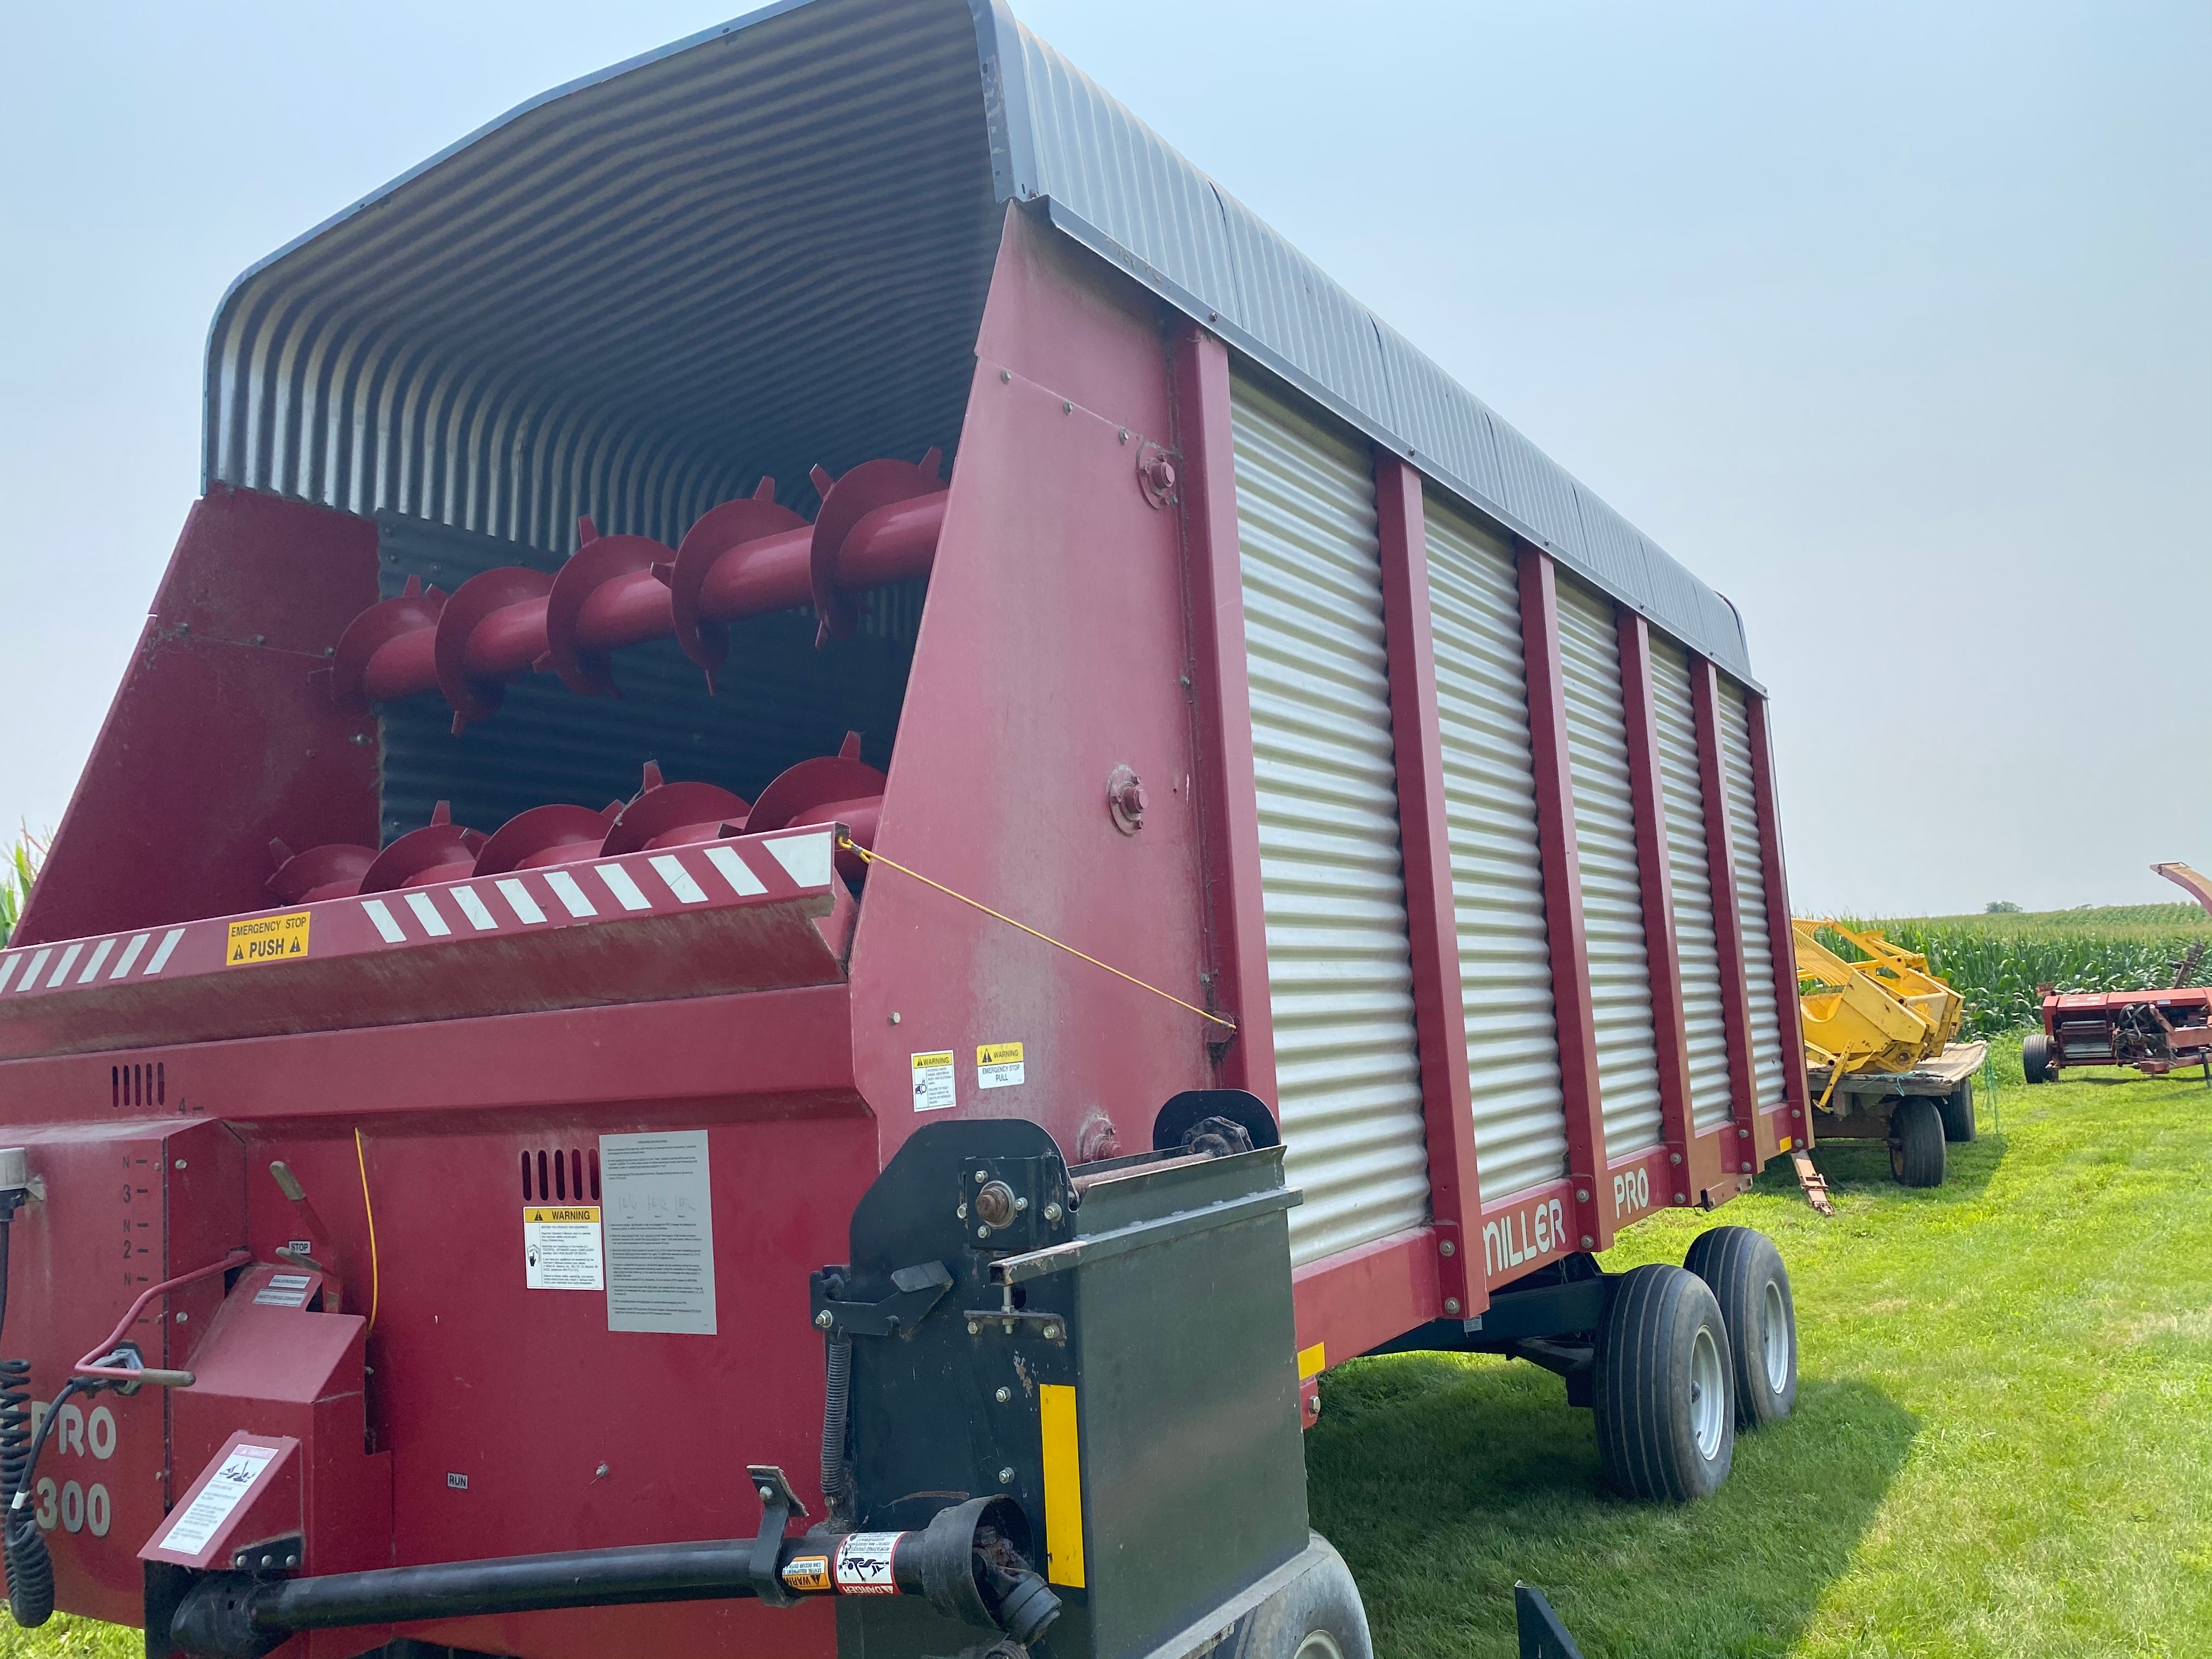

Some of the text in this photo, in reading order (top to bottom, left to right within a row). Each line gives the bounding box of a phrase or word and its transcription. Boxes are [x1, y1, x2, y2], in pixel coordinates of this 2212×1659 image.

[232, 917, 306, 937] EMERGENCY STOP
[250, 938, 284, 958] PUSH
[994, 1049, 1018, 1058] WARNING
[923, 1057, 949, 1065] WARNING
[983, 1065, 1008, 1074] EMERGENCY
[996, 1074, 1008, 1082] PULL
[179, 1097, 186, 1115] 4
[123, 1155, 129, 1169] N
[123, 1184, 131, 1203] 3
[1613, 1167, 1649, 1220] PRO
[551, 1211, 590, 1220] WARNING
[123, 1219, 131, 1232] N
[123, 1240, 131, 1259] 2
[291, 1243, 308, 1251] STOP
[124, 1273, 131, 1285] N
[31, 1401, 116, 1459] PRO
[449, 1475, 466, 1486] RUN
[843, 1585, 884, 1594] DANGER
